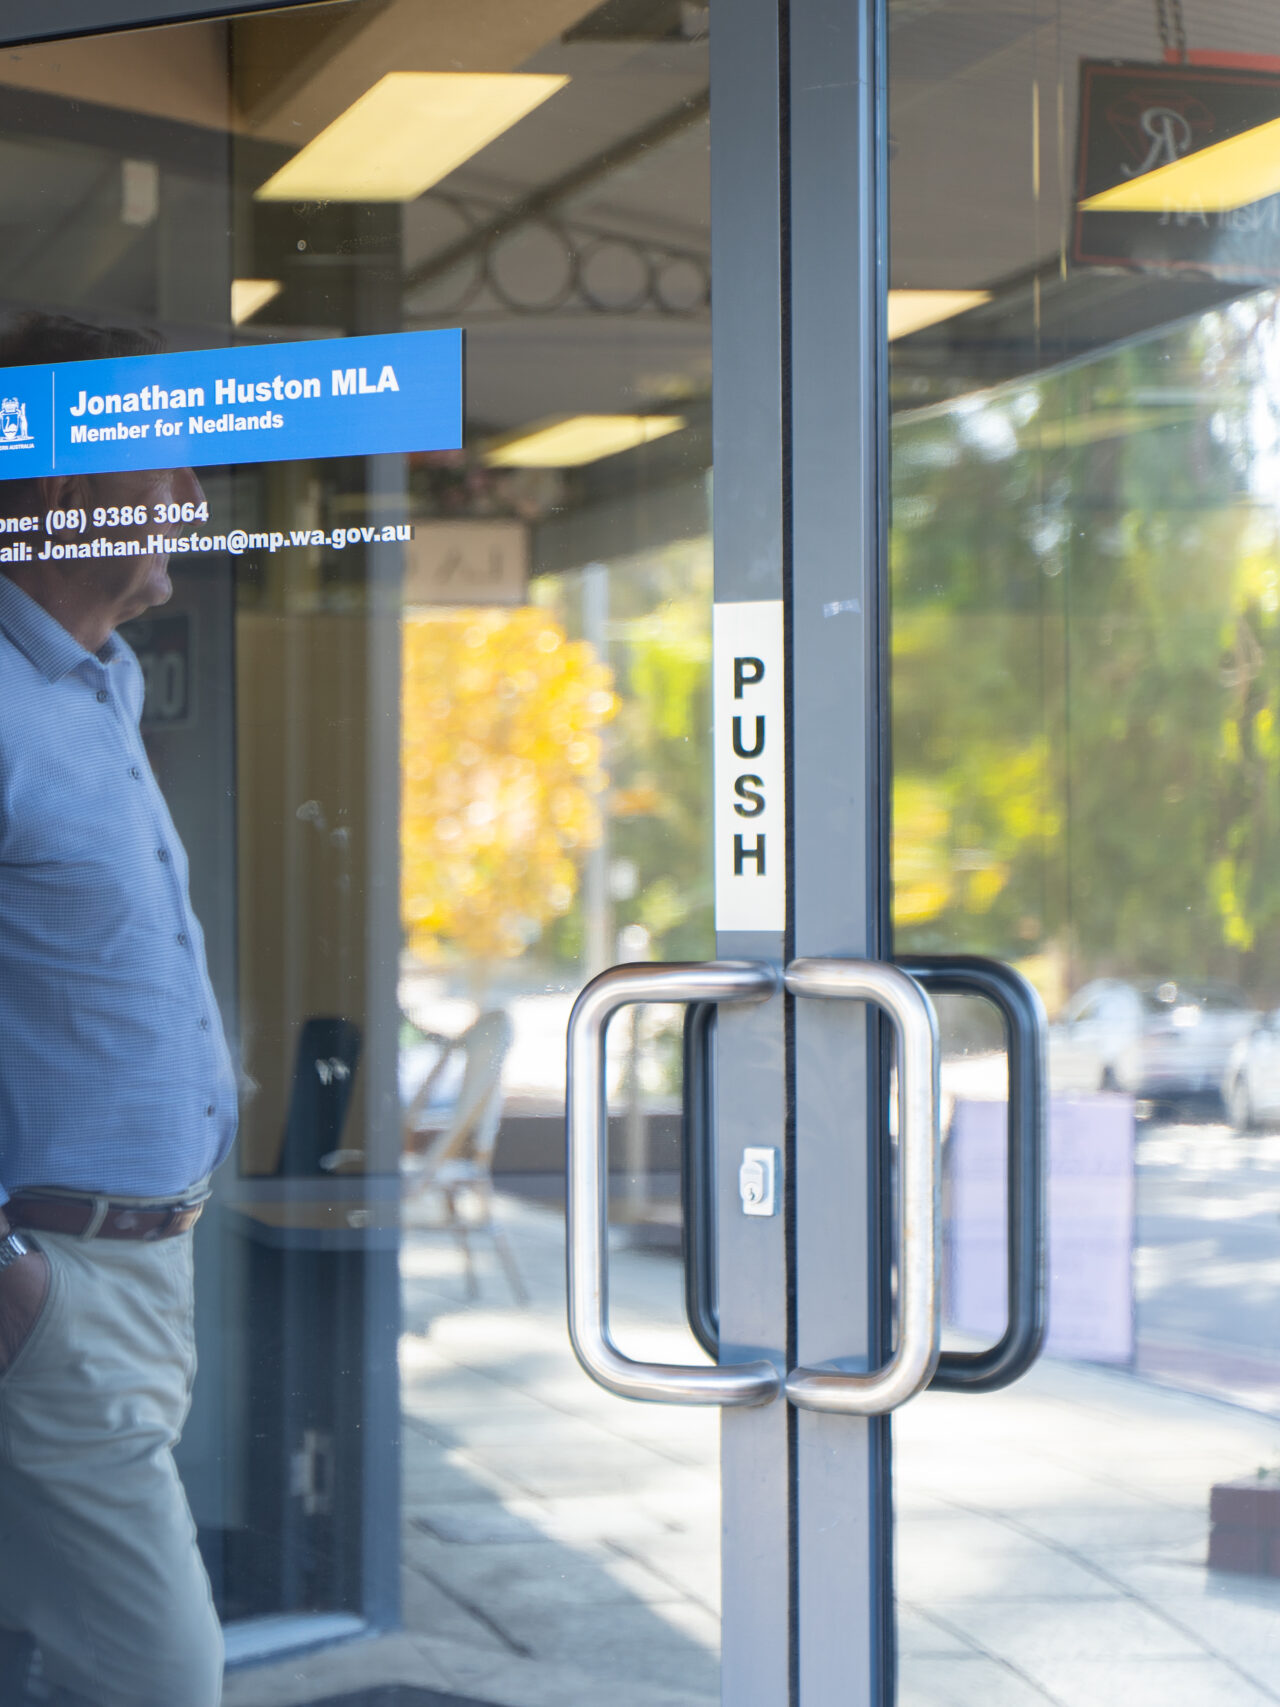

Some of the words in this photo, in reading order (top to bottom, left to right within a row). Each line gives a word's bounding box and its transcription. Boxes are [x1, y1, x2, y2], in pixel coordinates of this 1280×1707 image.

[70, 385, 205, 417] Jonathan
[215, 375, 321, 405] Huston
[331, 365, 400, 397] MLA
[70, 422, 150, 444] Member
[154, 419, 183, 437] for
[188, 411, 284, 434] Nedlands
[45, 508, 87, 535] (08)
[92, 505, 148, 528] 9386
[153, 501, 209, 524] 3064
[37, 524, 411, 560] Jonathan.Huston@mp.wa.gov.au
[732, 656, 767, 877] PUSH
